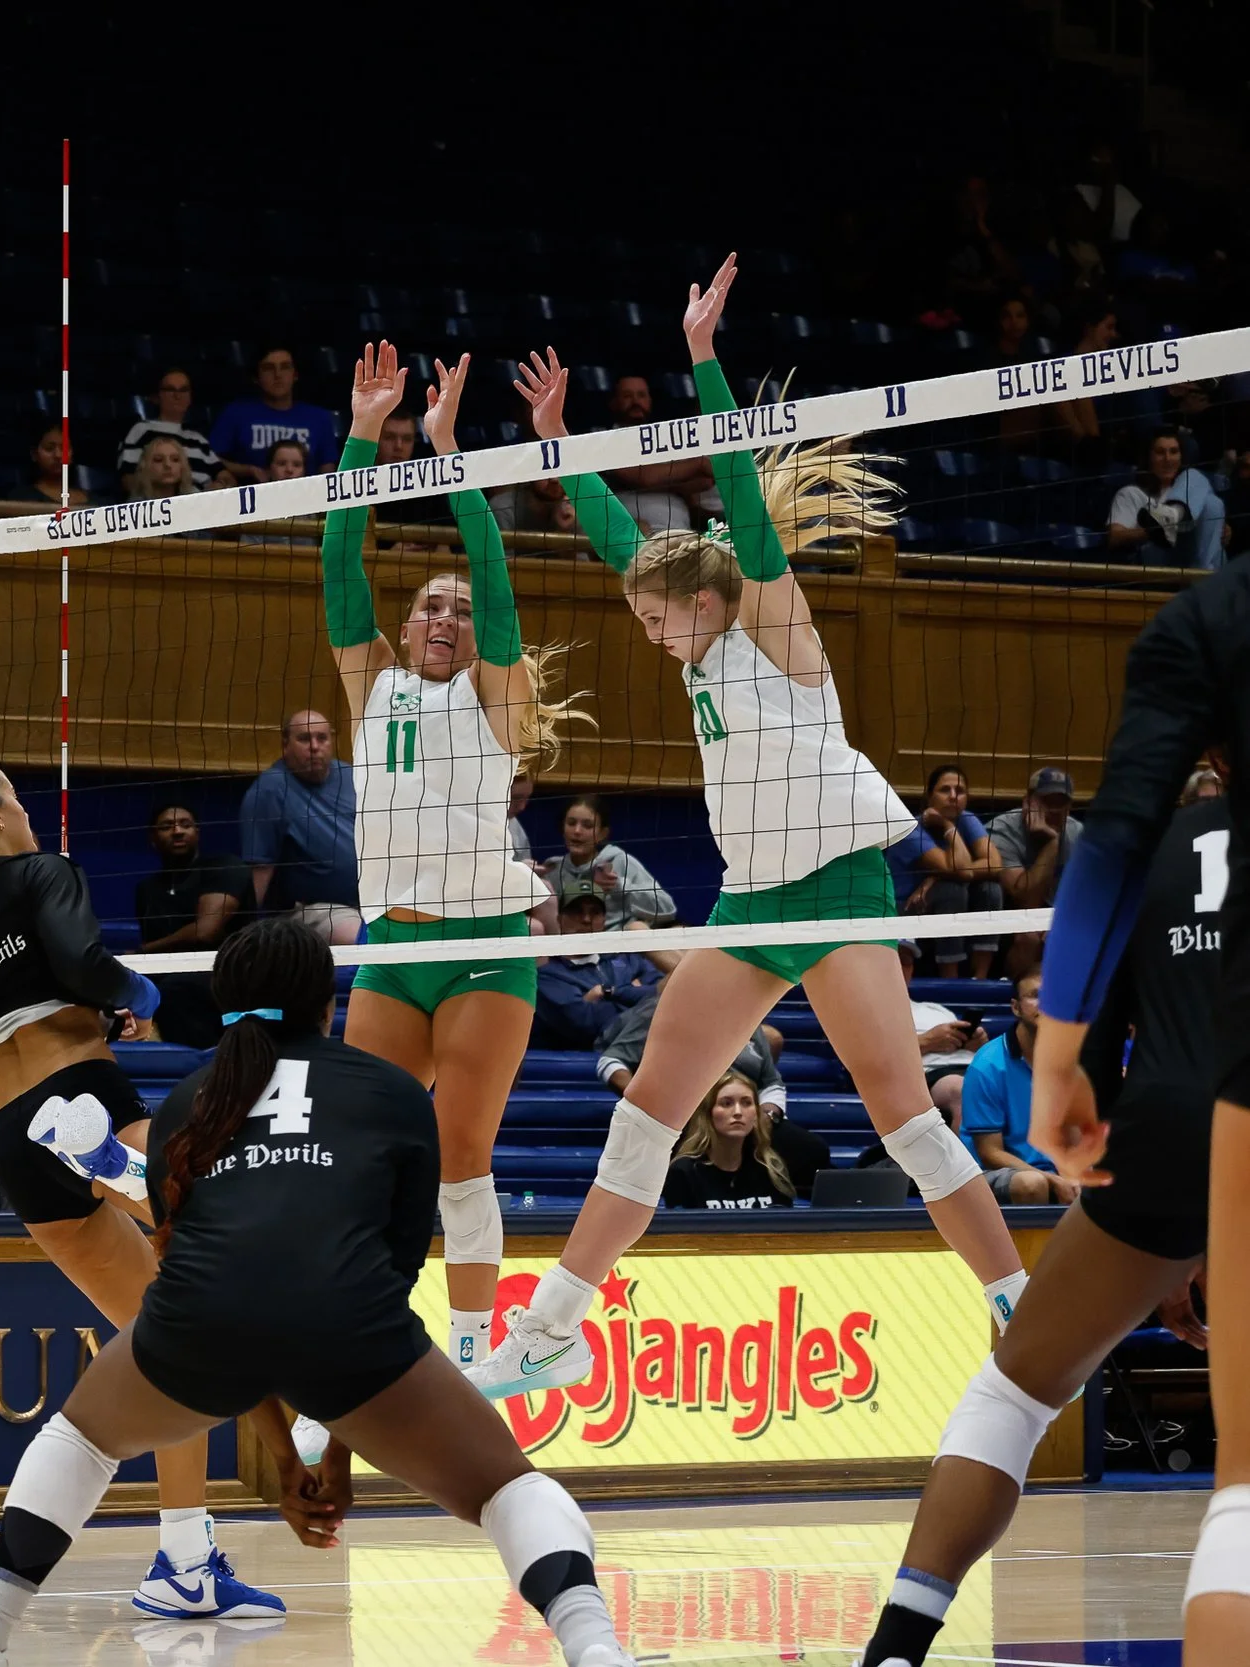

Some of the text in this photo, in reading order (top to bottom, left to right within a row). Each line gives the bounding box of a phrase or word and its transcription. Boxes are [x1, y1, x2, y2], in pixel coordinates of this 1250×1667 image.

[47, 510, 97, 540] BLUE
[105, 499, 172, 534] DEVILS
[326, 467, 378, 502] BLUE
[389, 454, 465, 493] DEVILS
[639, 417, 699, 455] BLUE
[712, 402, 797, 445] DEVILS
[998, 358, 1066, 401] BLUE
[1082, 341, 1180, 387] DEVILS
[386, 720, 416, 774] 11
[1168, 923, 1222, 957] Blu
[247, 1058, 313, 1136] 4
[244, 1143, 333, 1169] Devils
